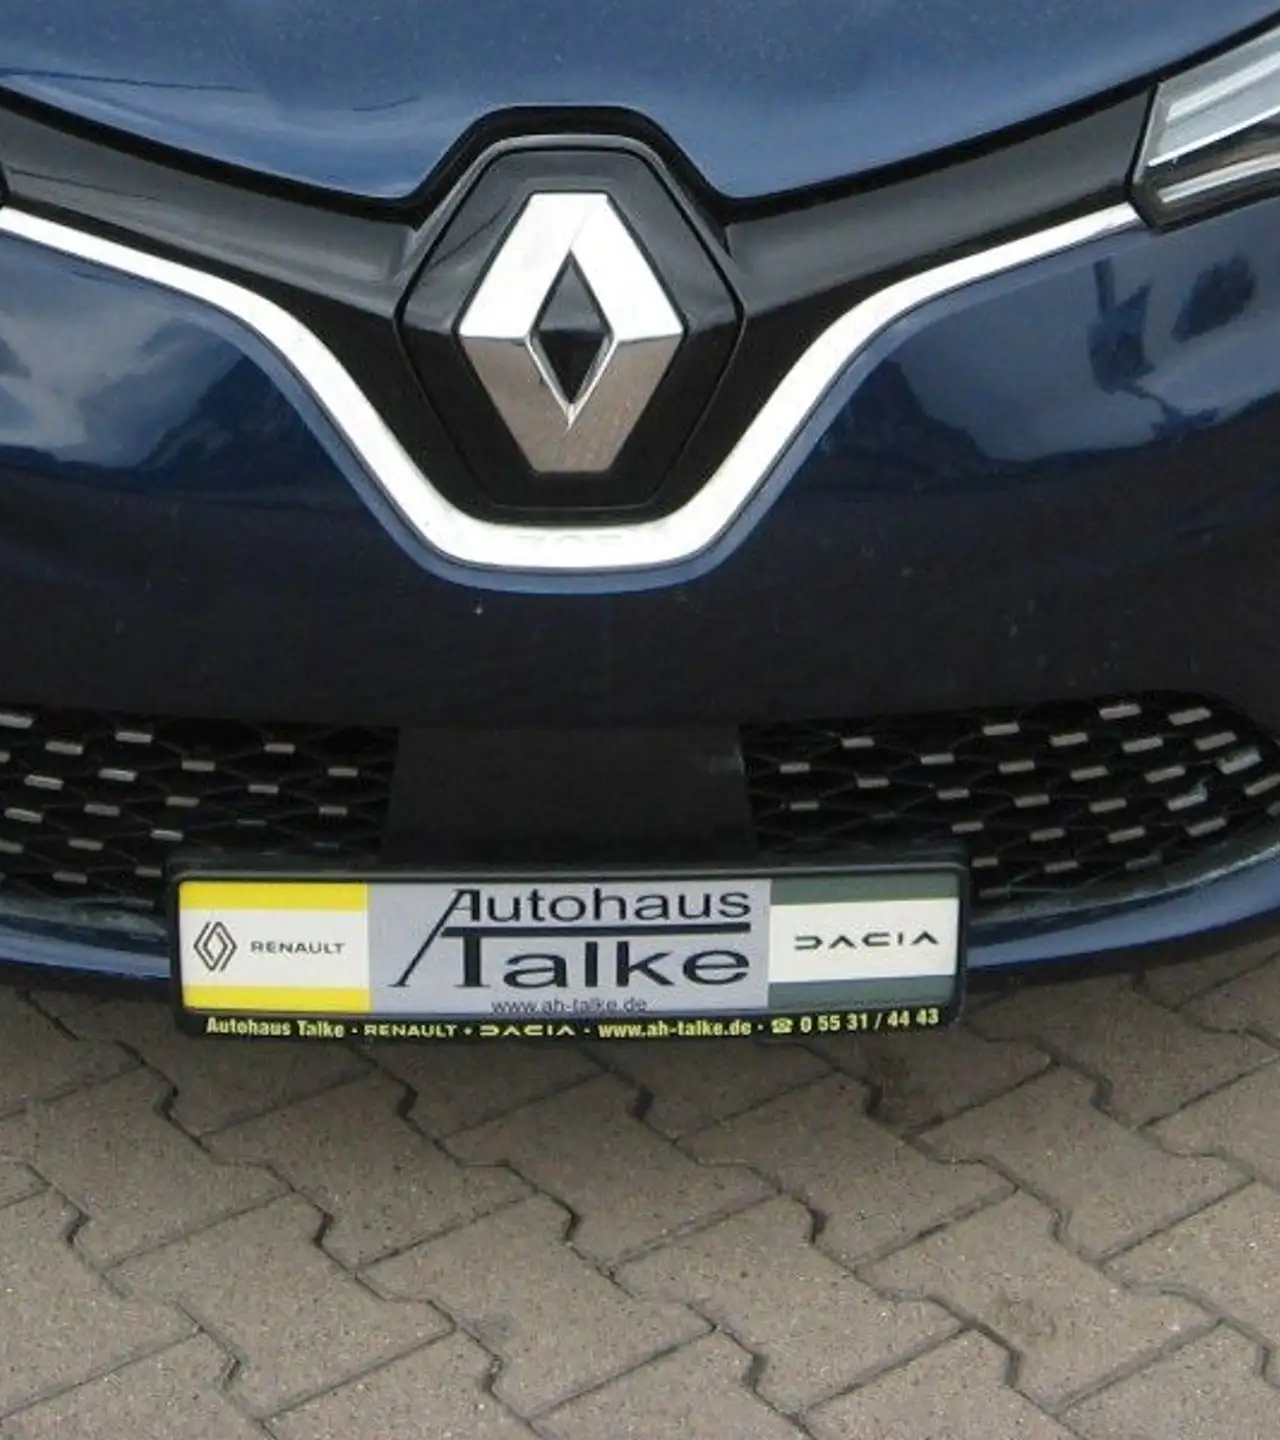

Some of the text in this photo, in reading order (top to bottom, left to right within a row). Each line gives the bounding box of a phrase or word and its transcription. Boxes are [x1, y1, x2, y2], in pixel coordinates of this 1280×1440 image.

[250, 940, 347, 955] RENAULT
[794, 931, 940, 951] DACIA
[440, 922, 752, 989] Talke
[490, 996, 649, 1014] www.ah-talke.de
[206, 1016, 292, 1037] Autohaus
[297, 1019, 345, 1038] Talke
[364, 1023, 458, 1038] RENAULT
[479, 1023, 576, 1037] DACIA
[598, 1019, 752, 1038] www.ah-talke.de
